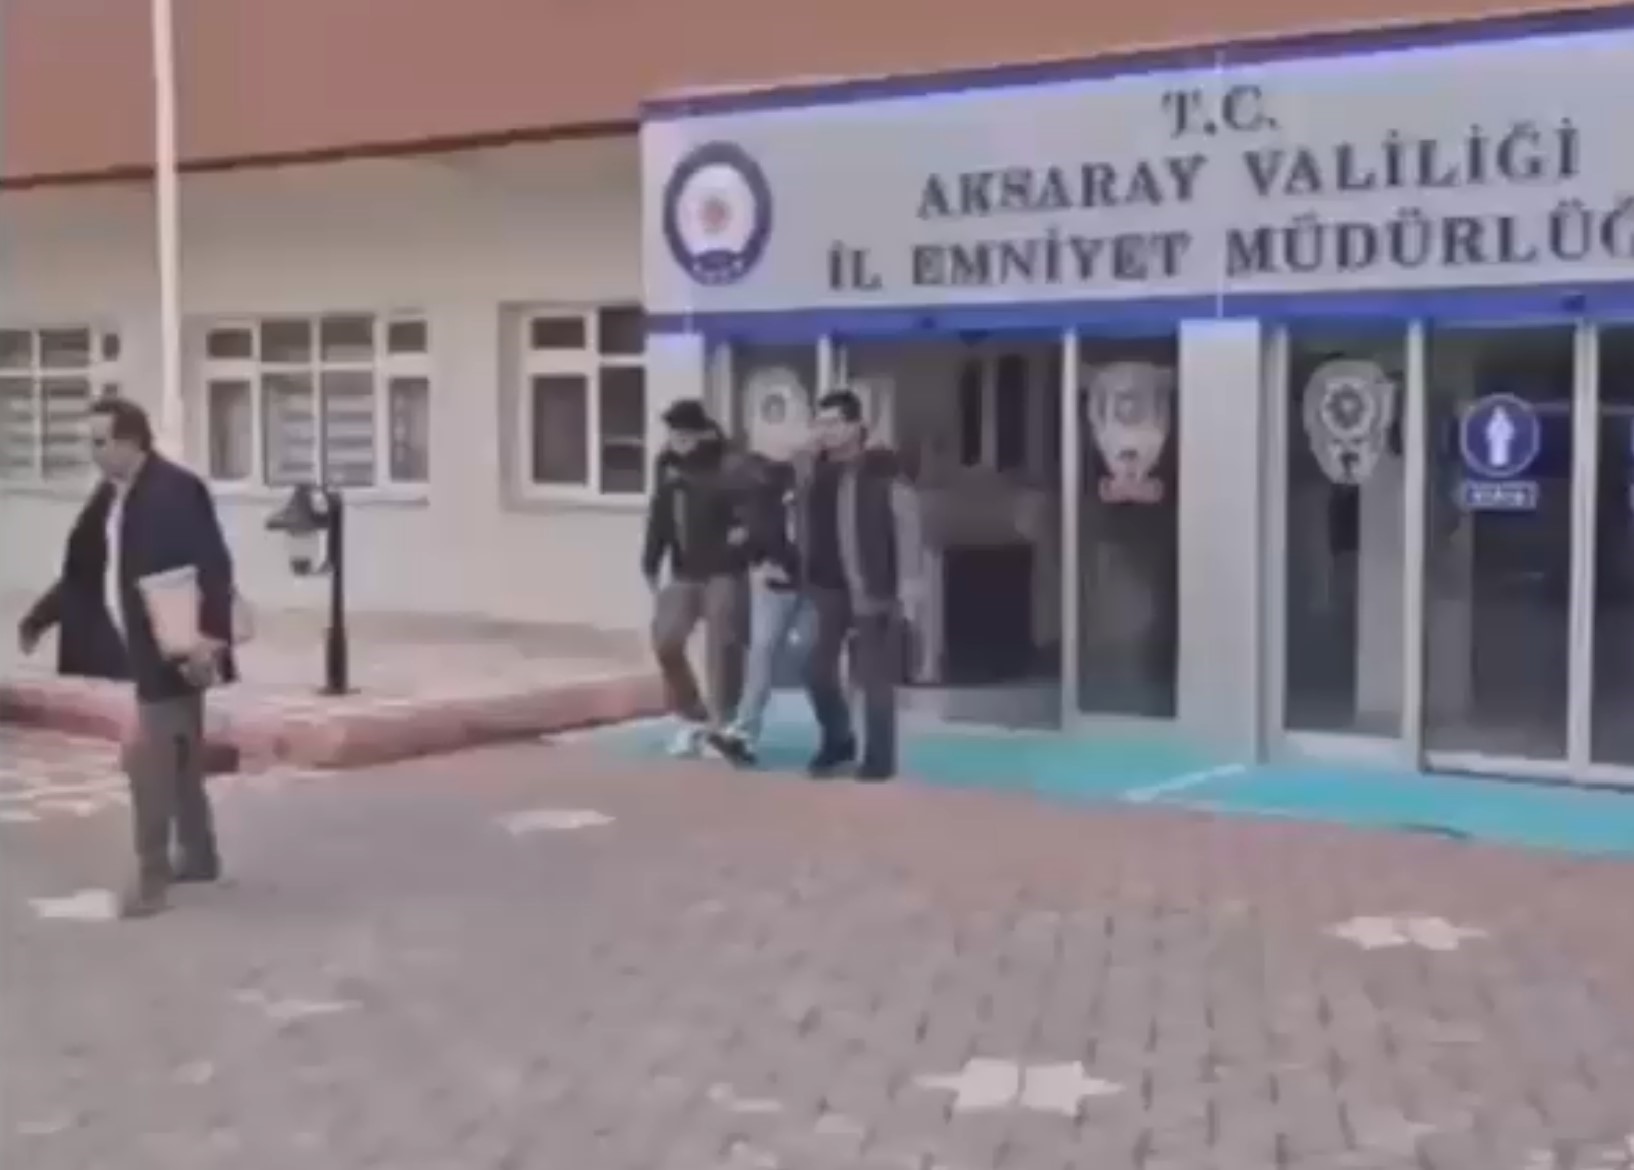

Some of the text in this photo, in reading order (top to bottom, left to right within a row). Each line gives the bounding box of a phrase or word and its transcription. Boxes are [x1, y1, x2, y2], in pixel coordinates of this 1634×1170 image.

[1163, 84, 1279, 138] T.C.
[916, 116, 1580, 219] AKSARAY VALİLİĞİ
[827, 240, 883, 291] İL
[911, 223, 1192, 286] EMNİYET
